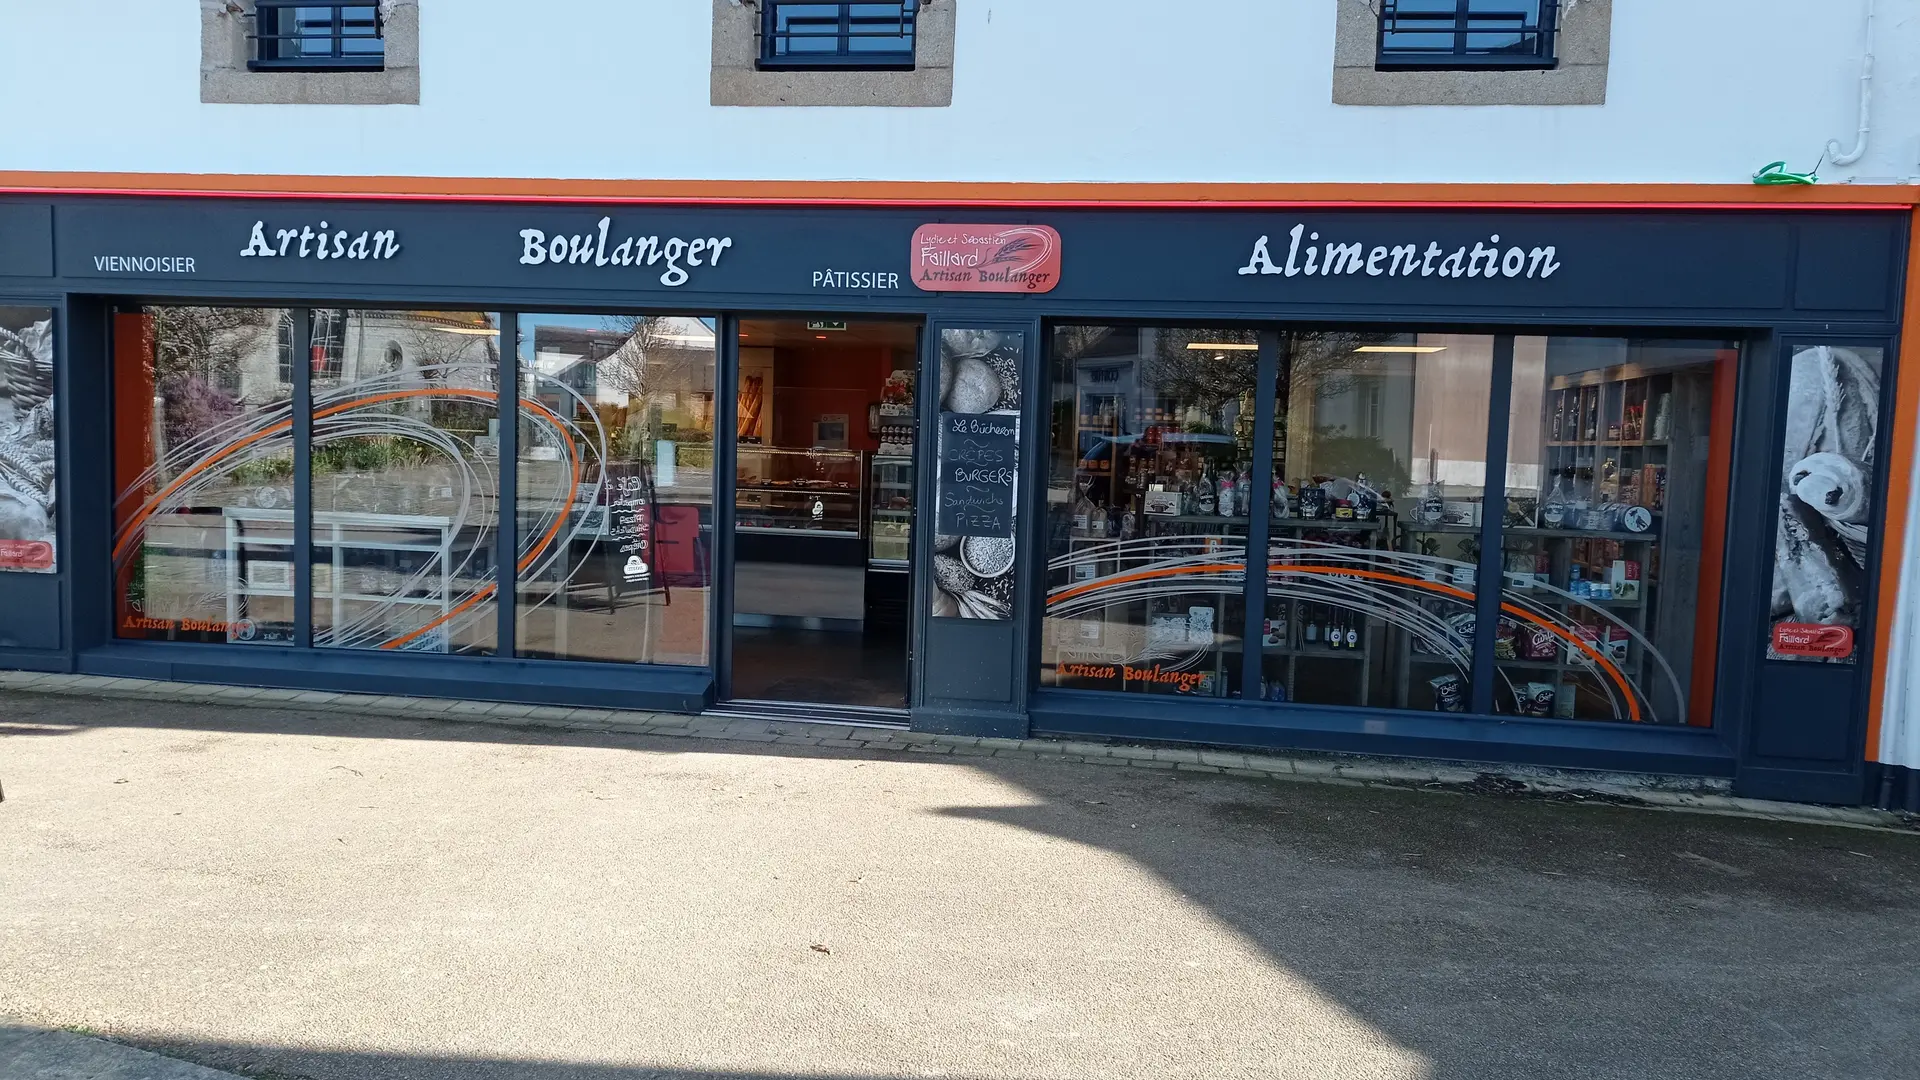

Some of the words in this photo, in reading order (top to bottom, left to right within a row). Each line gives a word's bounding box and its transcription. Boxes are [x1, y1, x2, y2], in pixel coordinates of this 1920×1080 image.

[240, 220, 401, 261] Artisan
[920, 233, 946, 247] Lydie
[947, 234, 958, 245] et
[518, 216, 732, 288] Boulanger
[921, 246, 979, 267] Faillard
[1237, 223, 1561, 280] Alimentation
[93, 255, 196, 274] VIENNOISIER
[812, 267, 899, 290] PÂTISSIER
[919, 268, 972, 283] Artisan
[979, 266, 1051, 289] Boulanger
[952, 419, 968, 434] Le
[122, 615, 176, 631] Artisan
[1779, 632, 1810, 644] Faillard
[1056, 661, 1116, 680] Artisan
[1123, 663, 1207, 692] Boulanger
